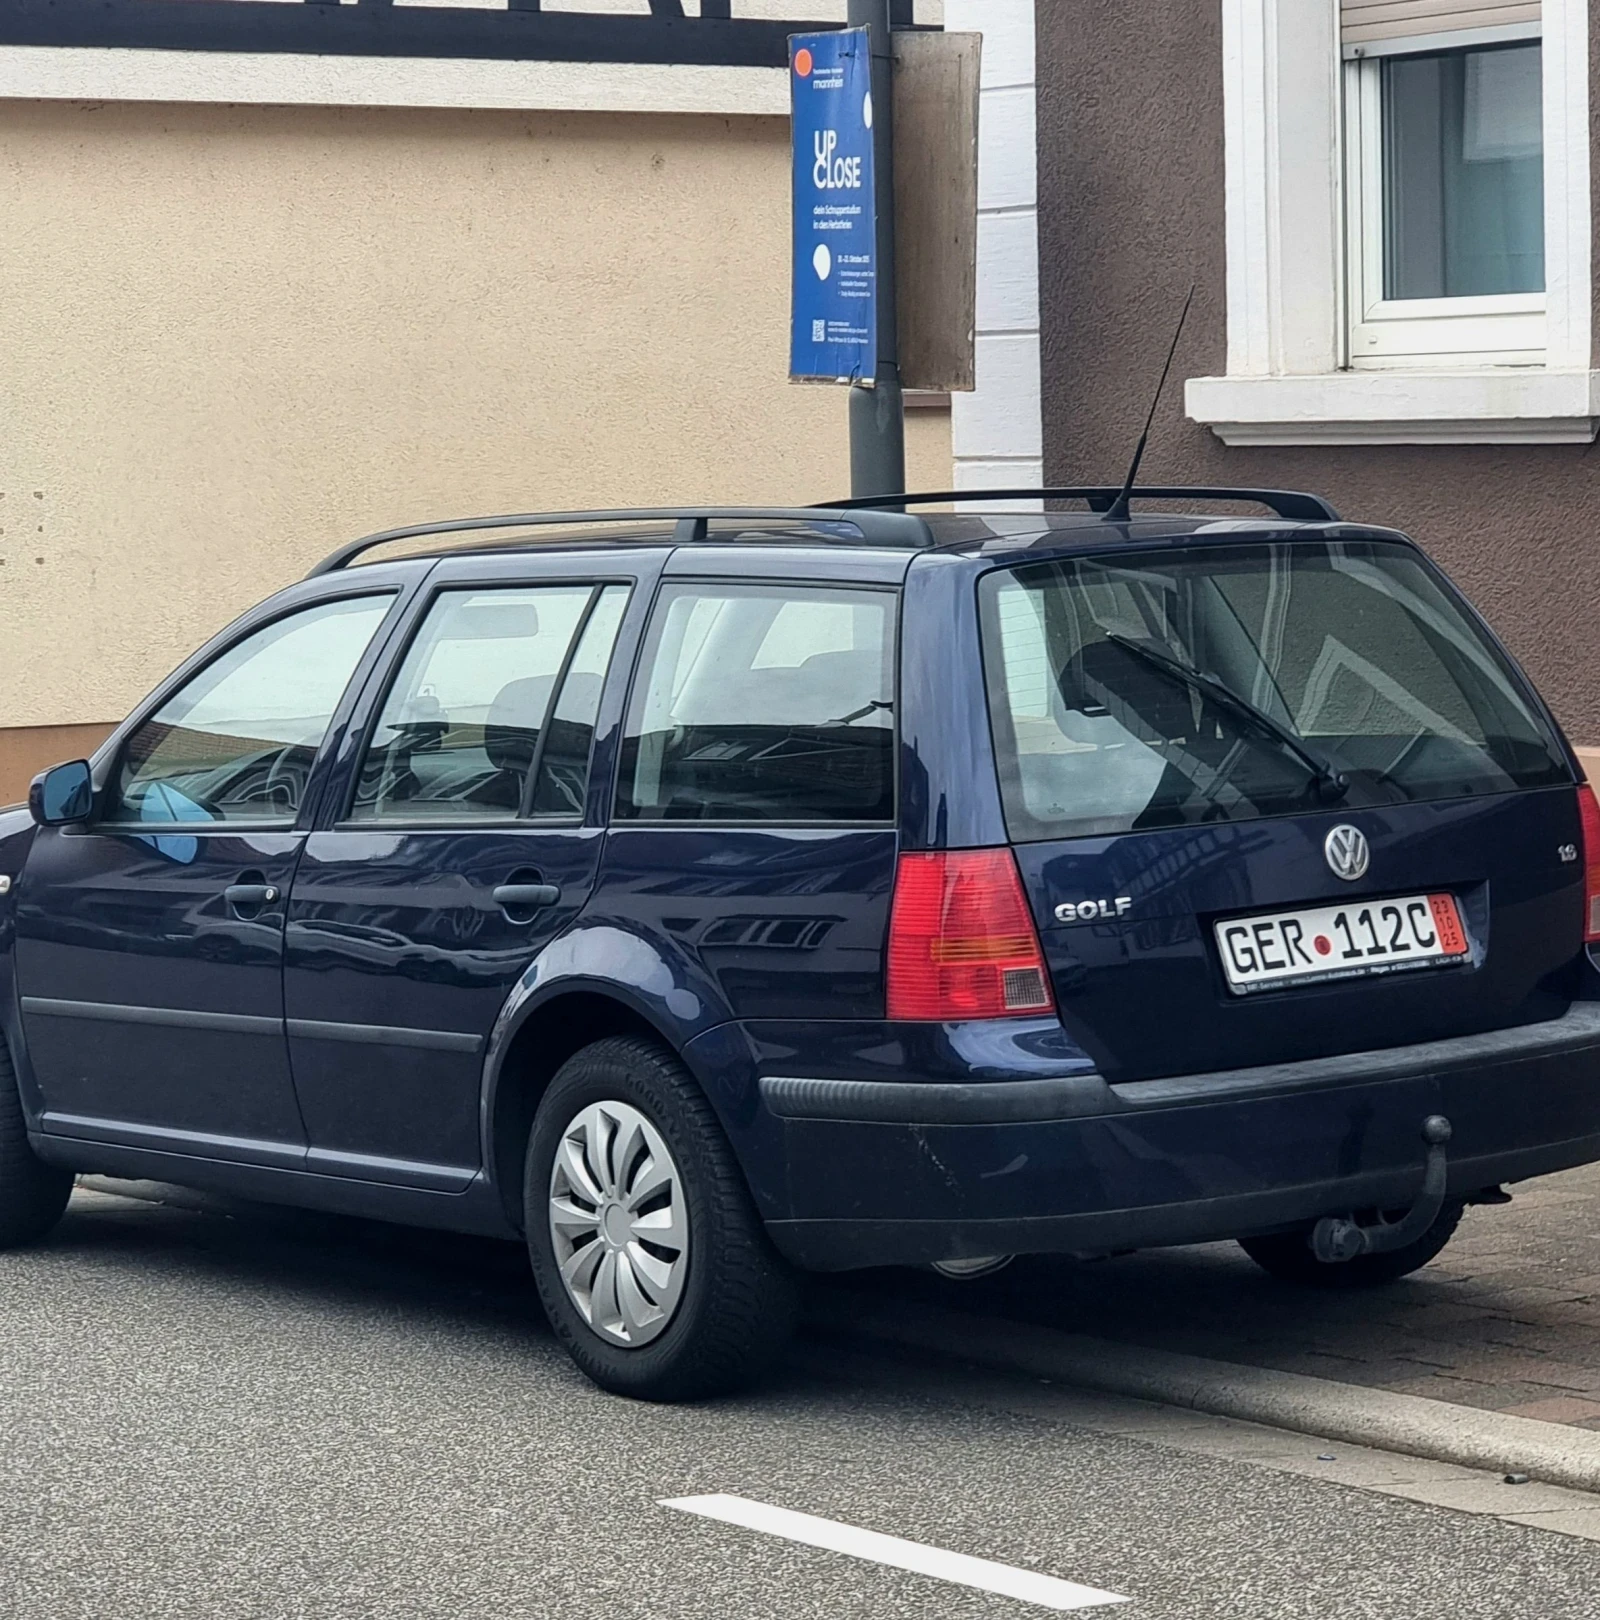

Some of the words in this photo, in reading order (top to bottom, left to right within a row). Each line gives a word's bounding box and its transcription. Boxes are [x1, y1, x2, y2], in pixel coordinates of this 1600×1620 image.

[814, 130, 837, 160] UP
[813, 156, 861, 189] CLOSE
[1325, 824, 1370, 881] VW
[1054, 897, 1132, 922] GOLF
[1433, 900, 1449, 914] 23
[1439, 916, 1454, 930] 10
[1225, 918, 1313, 974] GER
[1333, 903, 1436, 959] 112C
[1443, 931, 1459, 946] 25
